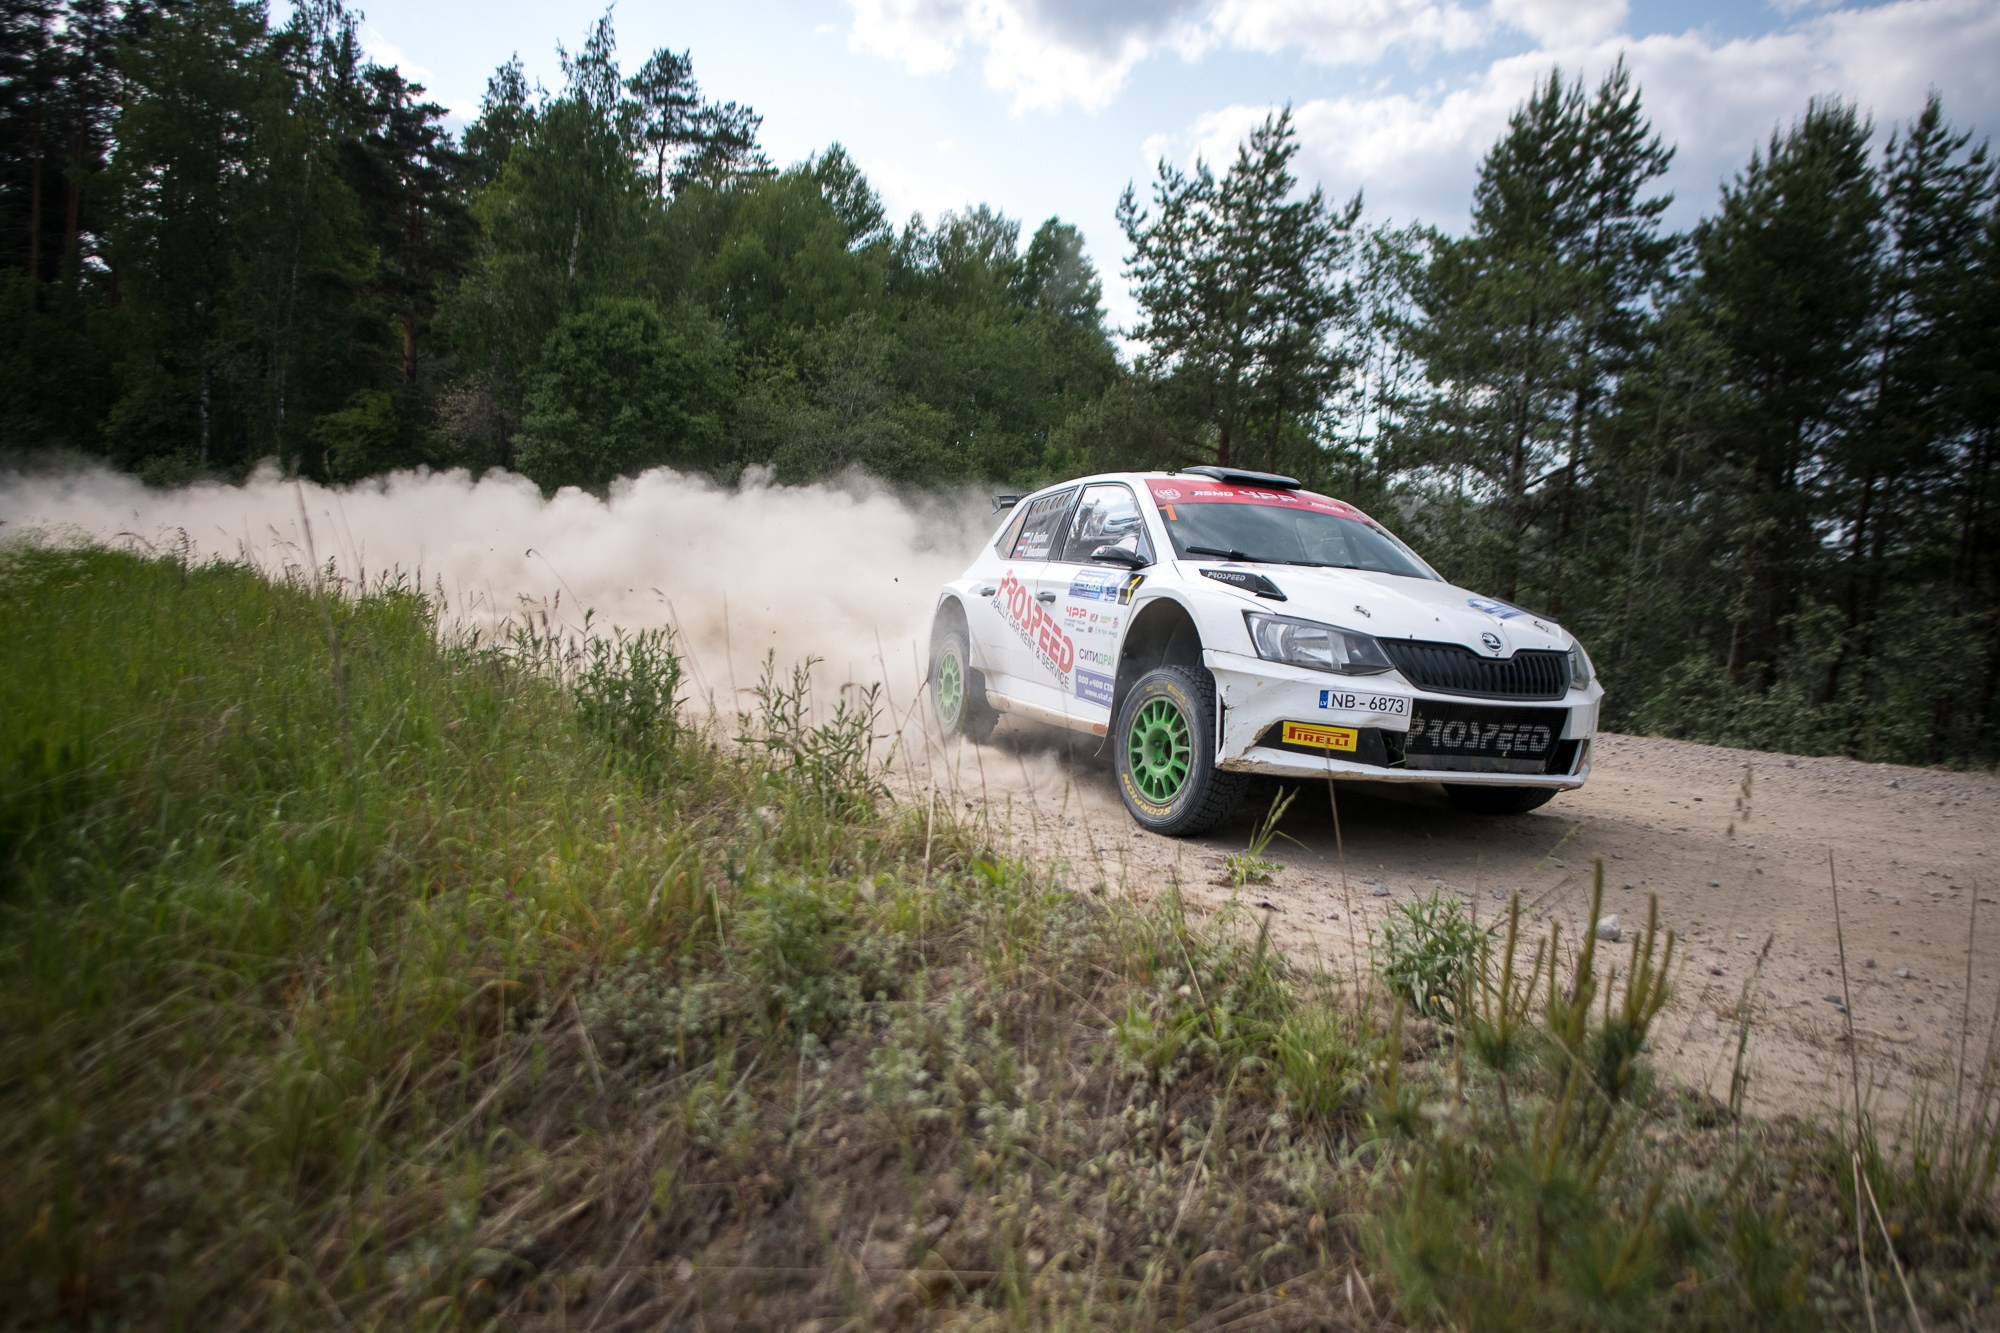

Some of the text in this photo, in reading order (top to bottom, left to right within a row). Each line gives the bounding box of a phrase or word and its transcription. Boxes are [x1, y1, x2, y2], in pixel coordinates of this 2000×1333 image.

[1158, 504, 1178, 521] 1
[1125, 575, 1142, 604] 1
[1207, 571, 1246, 581] PROSPEED
[997, 568, 1075, 674] PROSPEED
[991, 596, 1070, 690] RALLY CAR RENT & SERVICE
[1288, 726, 1351, 747] PIRELLI
[1406, 718, 1551, 752] PROSPEED
[1122, 773, 1172, 816] SCORPION
